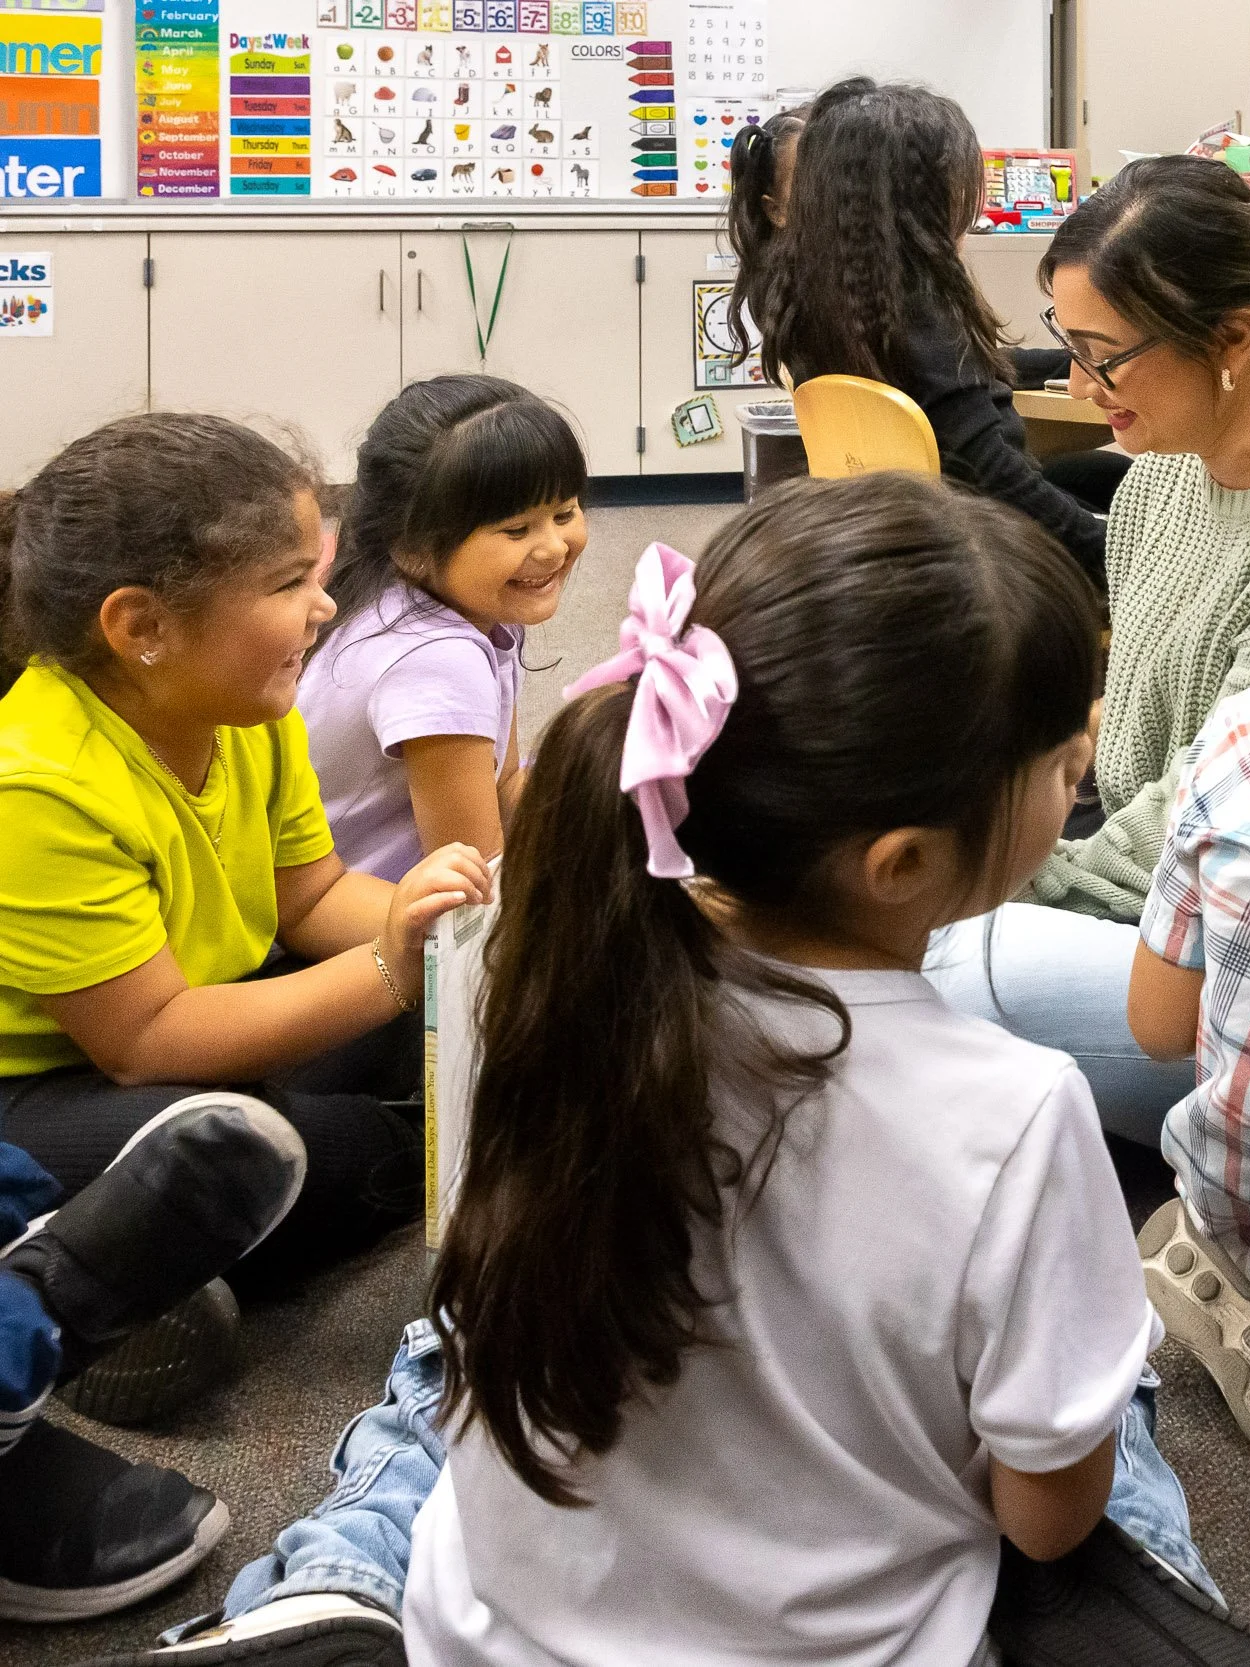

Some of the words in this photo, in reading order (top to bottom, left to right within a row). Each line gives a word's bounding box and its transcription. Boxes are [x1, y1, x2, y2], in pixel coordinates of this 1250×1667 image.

[328, 6, 337, 23] 1
[361, 6, 373, 23] 2
[395, 8, 407, 25] 3
[463, 9, 475, 26] 5
[495, 10, 507, 27] 6
[528, 11, 540, 28] 7
[560, 12, 572, 29] 8
[592, 12, 605, 29] 9
[623, 12, 644, 30] 10
[689, 19, 695, 28] 2
[706, 19, 713, 29] 5
[740, 21, 746, 29] 4
[755, 21, 762, 30] 3
[160, 28, 203, 38] March
[230, 33, 262, 54] Days
[273, 33, 309, 49] Week
[689, 36, 695, 45] 8
[706, 37, 713, 46] 6
[722, 37, 729, 46] 9
[740, 37, 746, 47] 7
[755, 38, 764, 47] 10
[163, 46, 193, 56] April
[571, 45, 621, 57] COLORS
[0, 42, 102, 75] mer
[689, 53, 696, 63] 12
[244, 58, 275, 72] Sunday
[348, 65, 357, 73] A
[161, 65, 189, 76] May
[374, 66, 381, 76] b
[428, 68, 435, 77] C
[454, 69, 460, 78] d
[737, 72, 745, 81] 17
[752, 73, 765, 82] 20
[160, 98, 182, 108] July
[244, 100, 277, 113] Tuesday
[349, 106, 357, 115] G
[159, 115, 199, 125] August
[159, 133, 219, 143] September
[242, 139, 279, 152] Thursday
[427, 145, 436, 154] O
[159, 151, 204, 160] October
[248, 159, 272, 172] Friday
[159, 167, 216, 177] November
[158, 184, 214, 193] December
[388, 187, 395, 196] U
[464, 186, 474, 194] W
[426, 974, 434, 1002] Simon
[426, 1067, 435, 1089] You"
[427, 1092, 435, 1113] Love
[427, 1127, 438, 1147] Says
[427, 1149, 435, 1169] Dad
[428, 1181, 436, 1209] When
